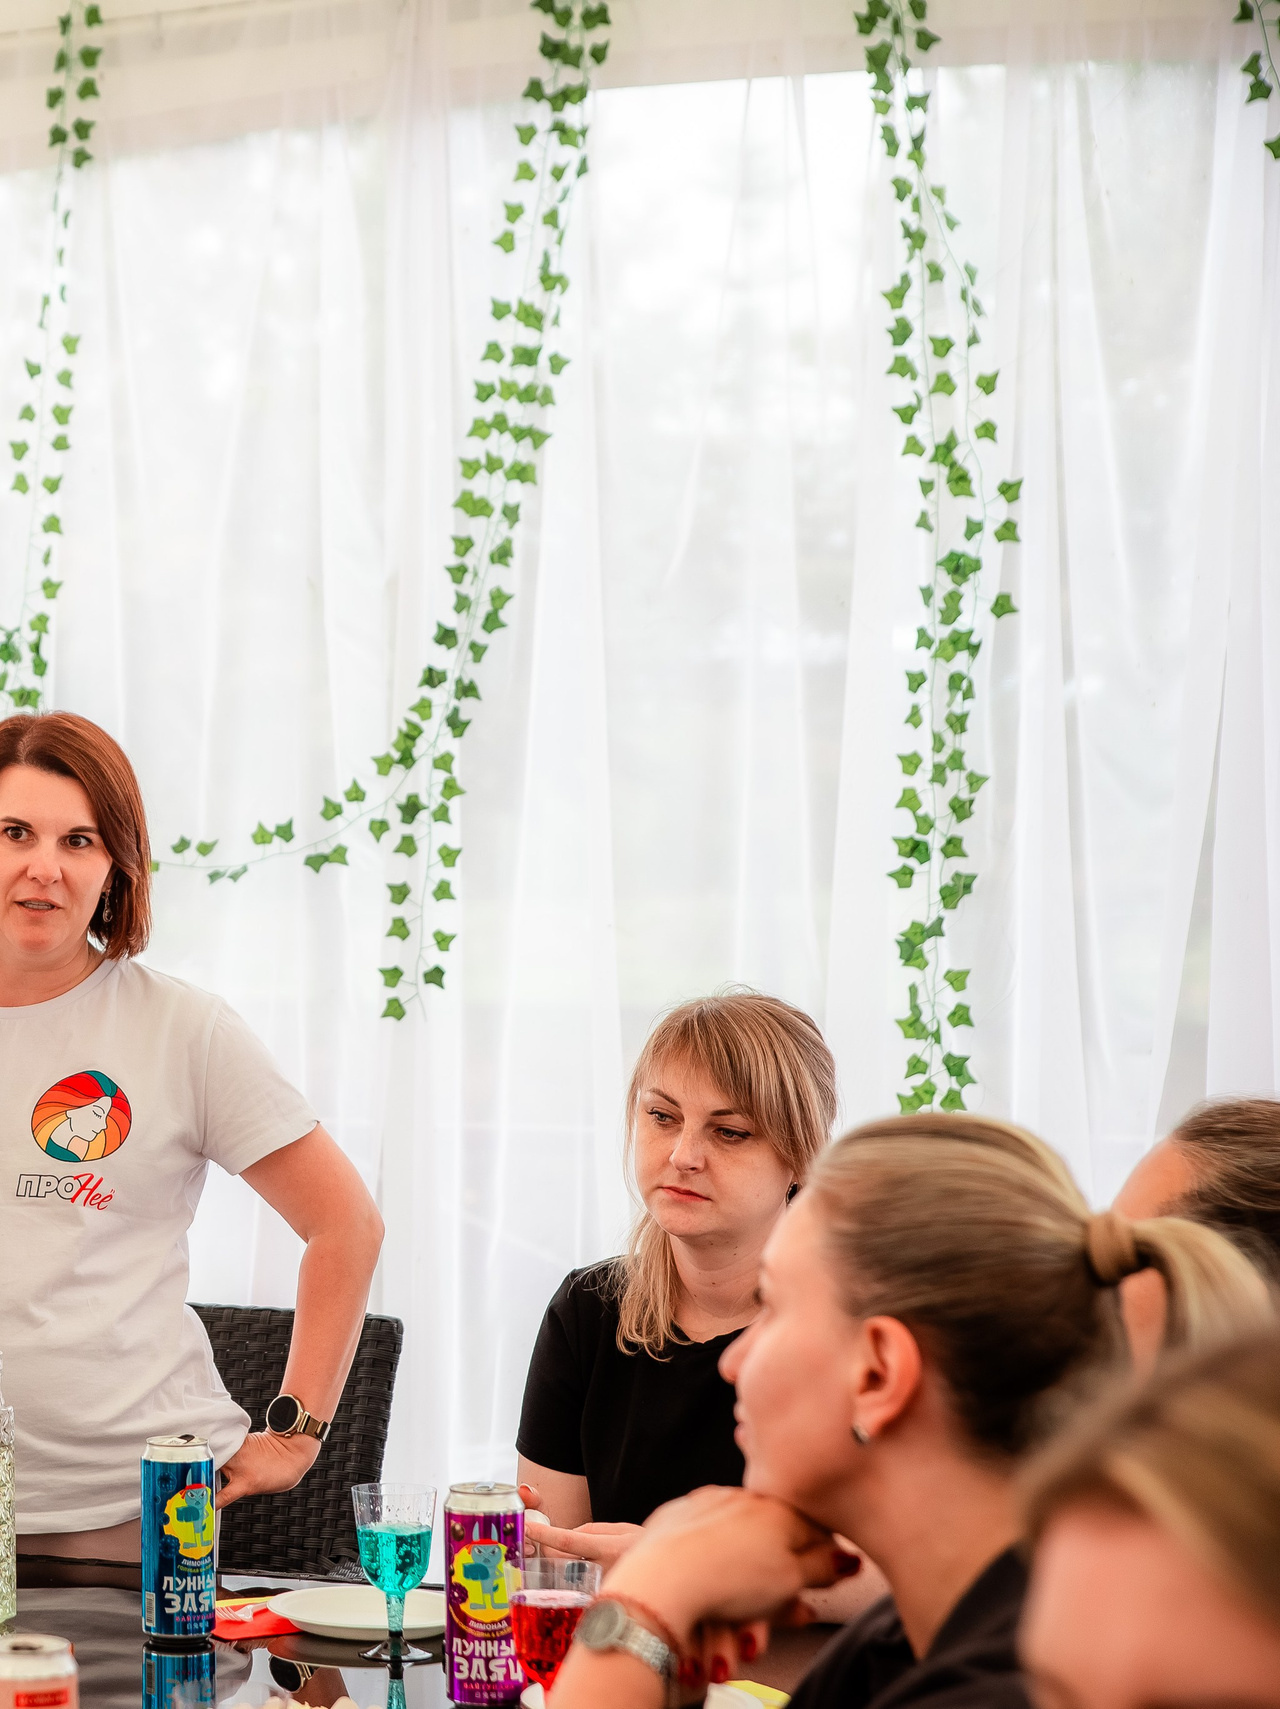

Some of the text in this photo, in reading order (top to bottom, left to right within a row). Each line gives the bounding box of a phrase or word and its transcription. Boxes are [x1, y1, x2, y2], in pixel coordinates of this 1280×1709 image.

[162, 1573, 216, 1591] ЛУННЫ
[469, 1619, 508, 1631] ЛИМОНАД
[452, 1637, 516, 1658] ЛУННЫ
